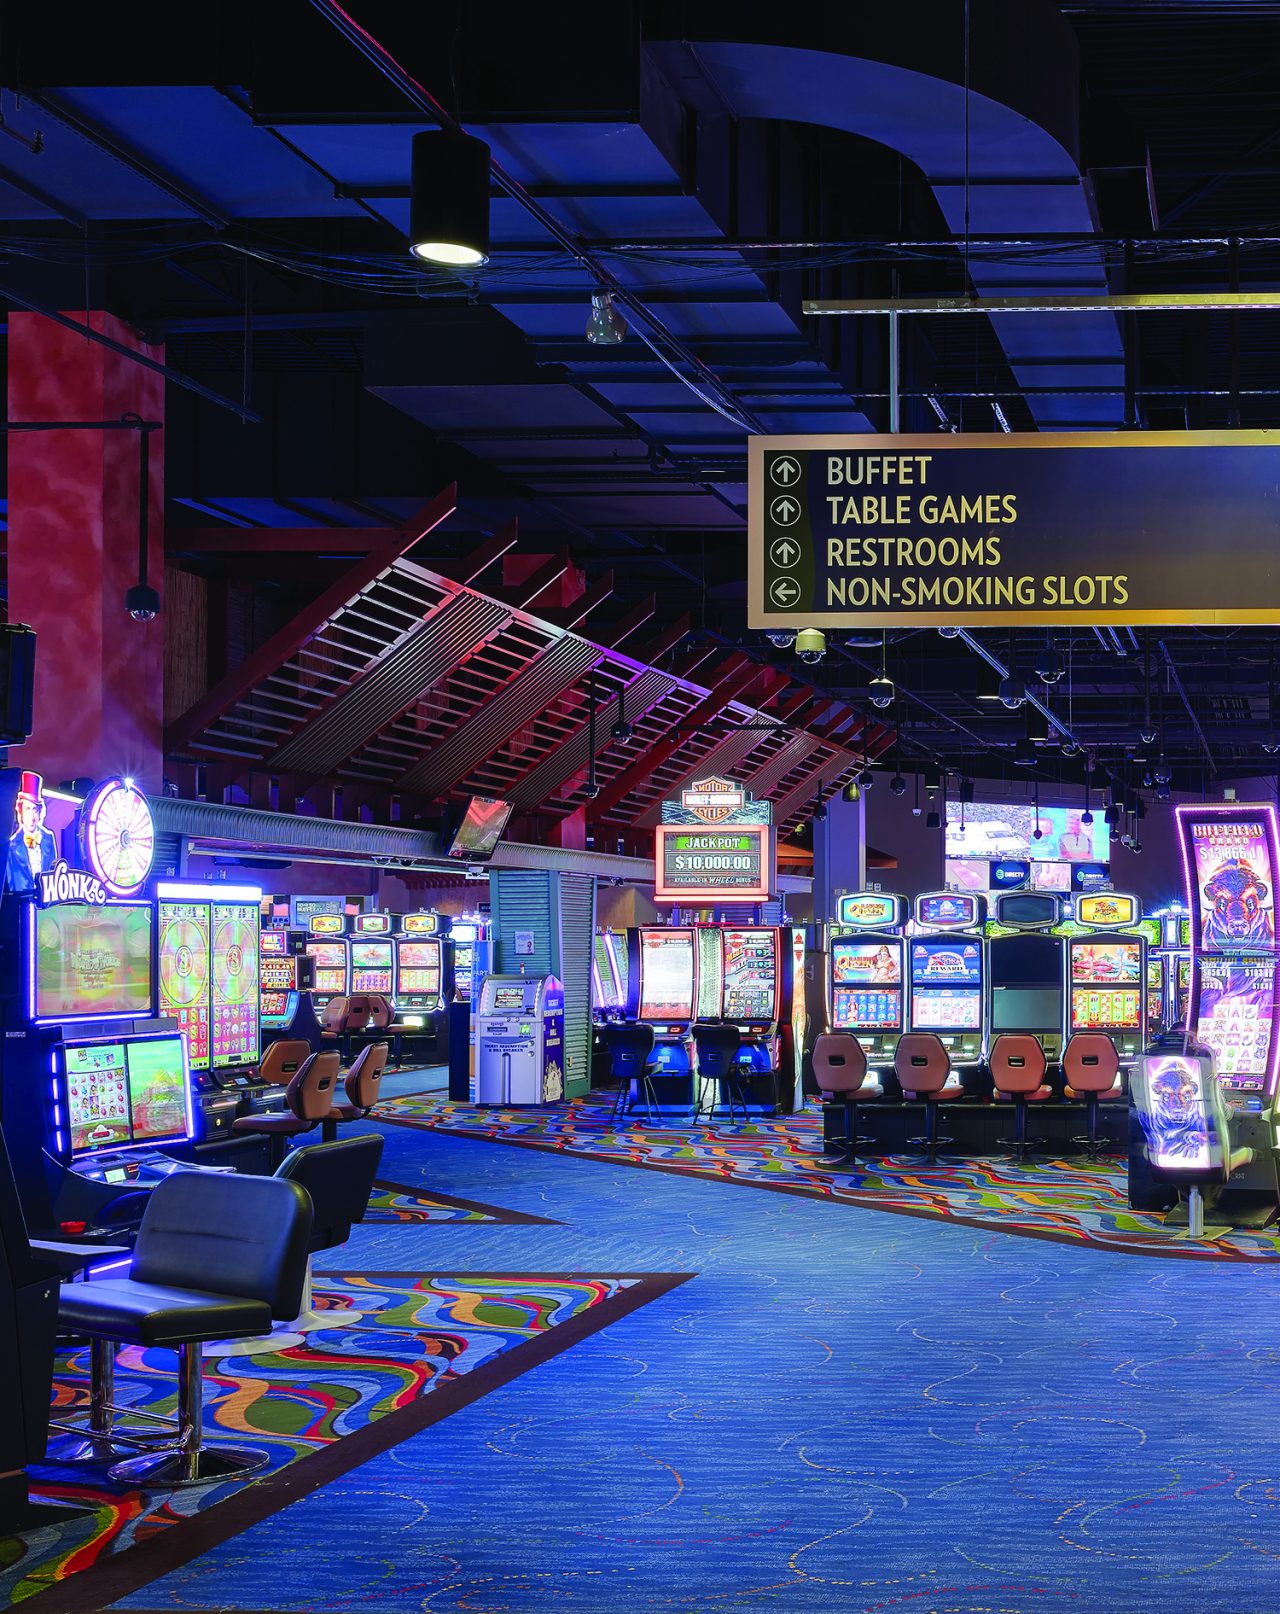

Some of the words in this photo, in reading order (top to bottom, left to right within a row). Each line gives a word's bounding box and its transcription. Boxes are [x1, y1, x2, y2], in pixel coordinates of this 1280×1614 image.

[827, 456, 932, 485] BUFFET
[826, 496, 911, 525] TABLE
[919, 495, 1017, 525] GAMES
[827, 537, 1001, 566] RESTROOMS
[827, 576, 1034, 606] NON-SMOKING
[1042, 575, 1129, 605] SLOTS
[698, 780, 728, 791] MOTOR
[698, 807, 729, 820] CYCLES
[686, 837, 741, 849] JACKPOT
[675, 856, 751, 870] $10,000.00
[42, 862, 107, 904] WONKA
[709, 876, 734, 884] WHEEL
